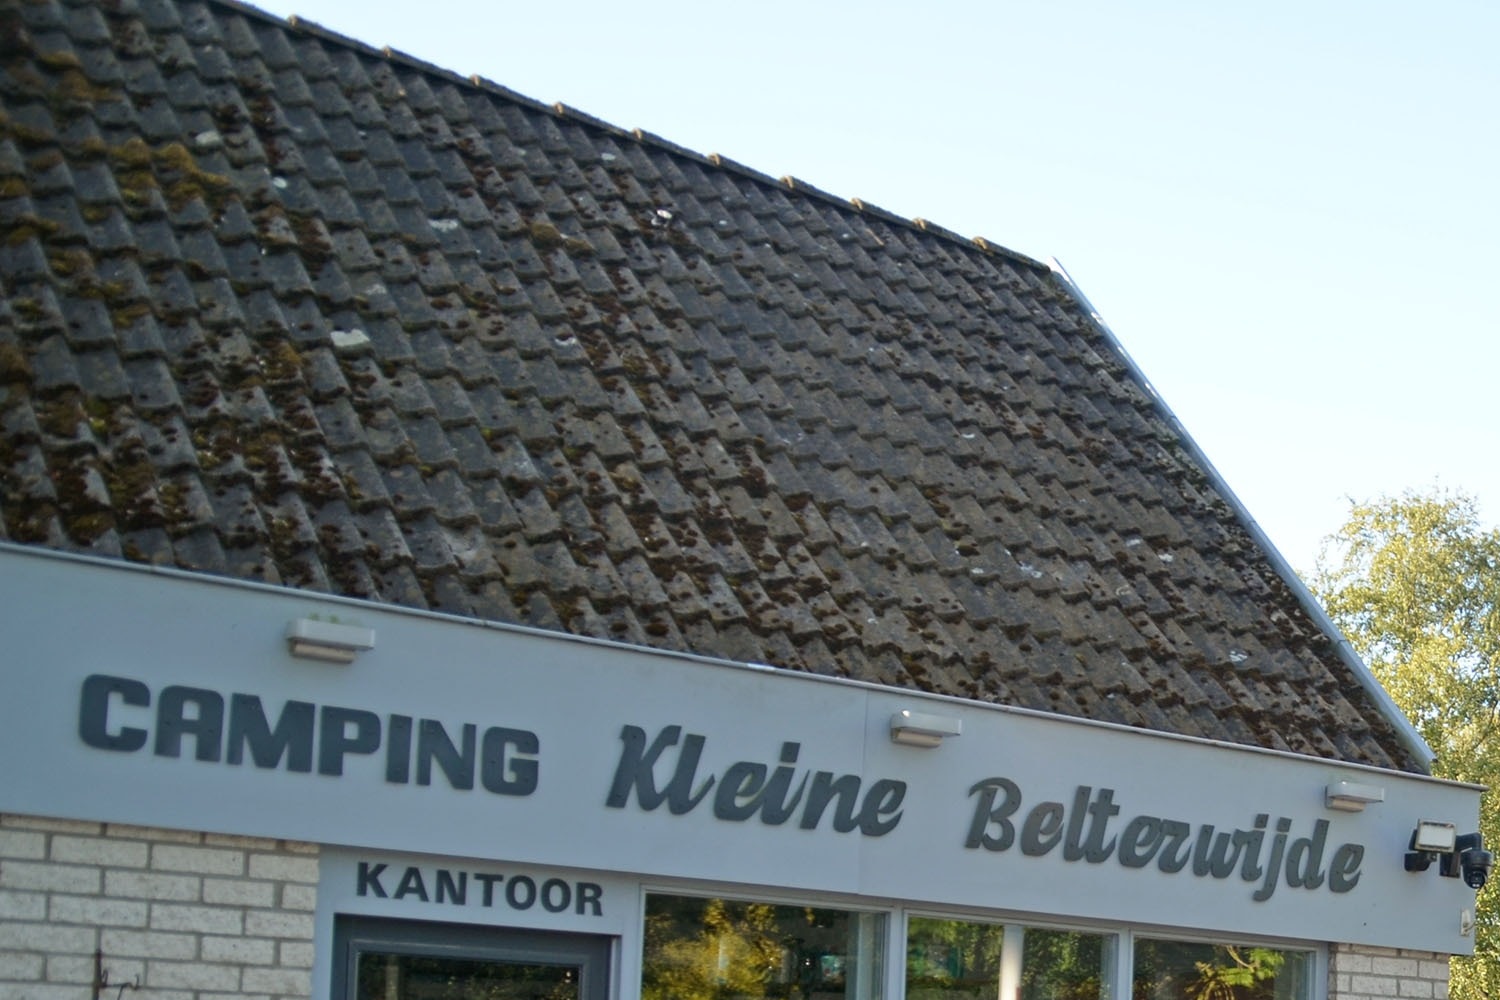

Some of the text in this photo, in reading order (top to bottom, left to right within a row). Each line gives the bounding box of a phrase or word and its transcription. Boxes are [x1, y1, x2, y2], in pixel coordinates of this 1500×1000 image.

[79, 674, 1364, 902] CAMPING Kleine Belterwijde
[356, 862, 604, 917] KANTOOR
